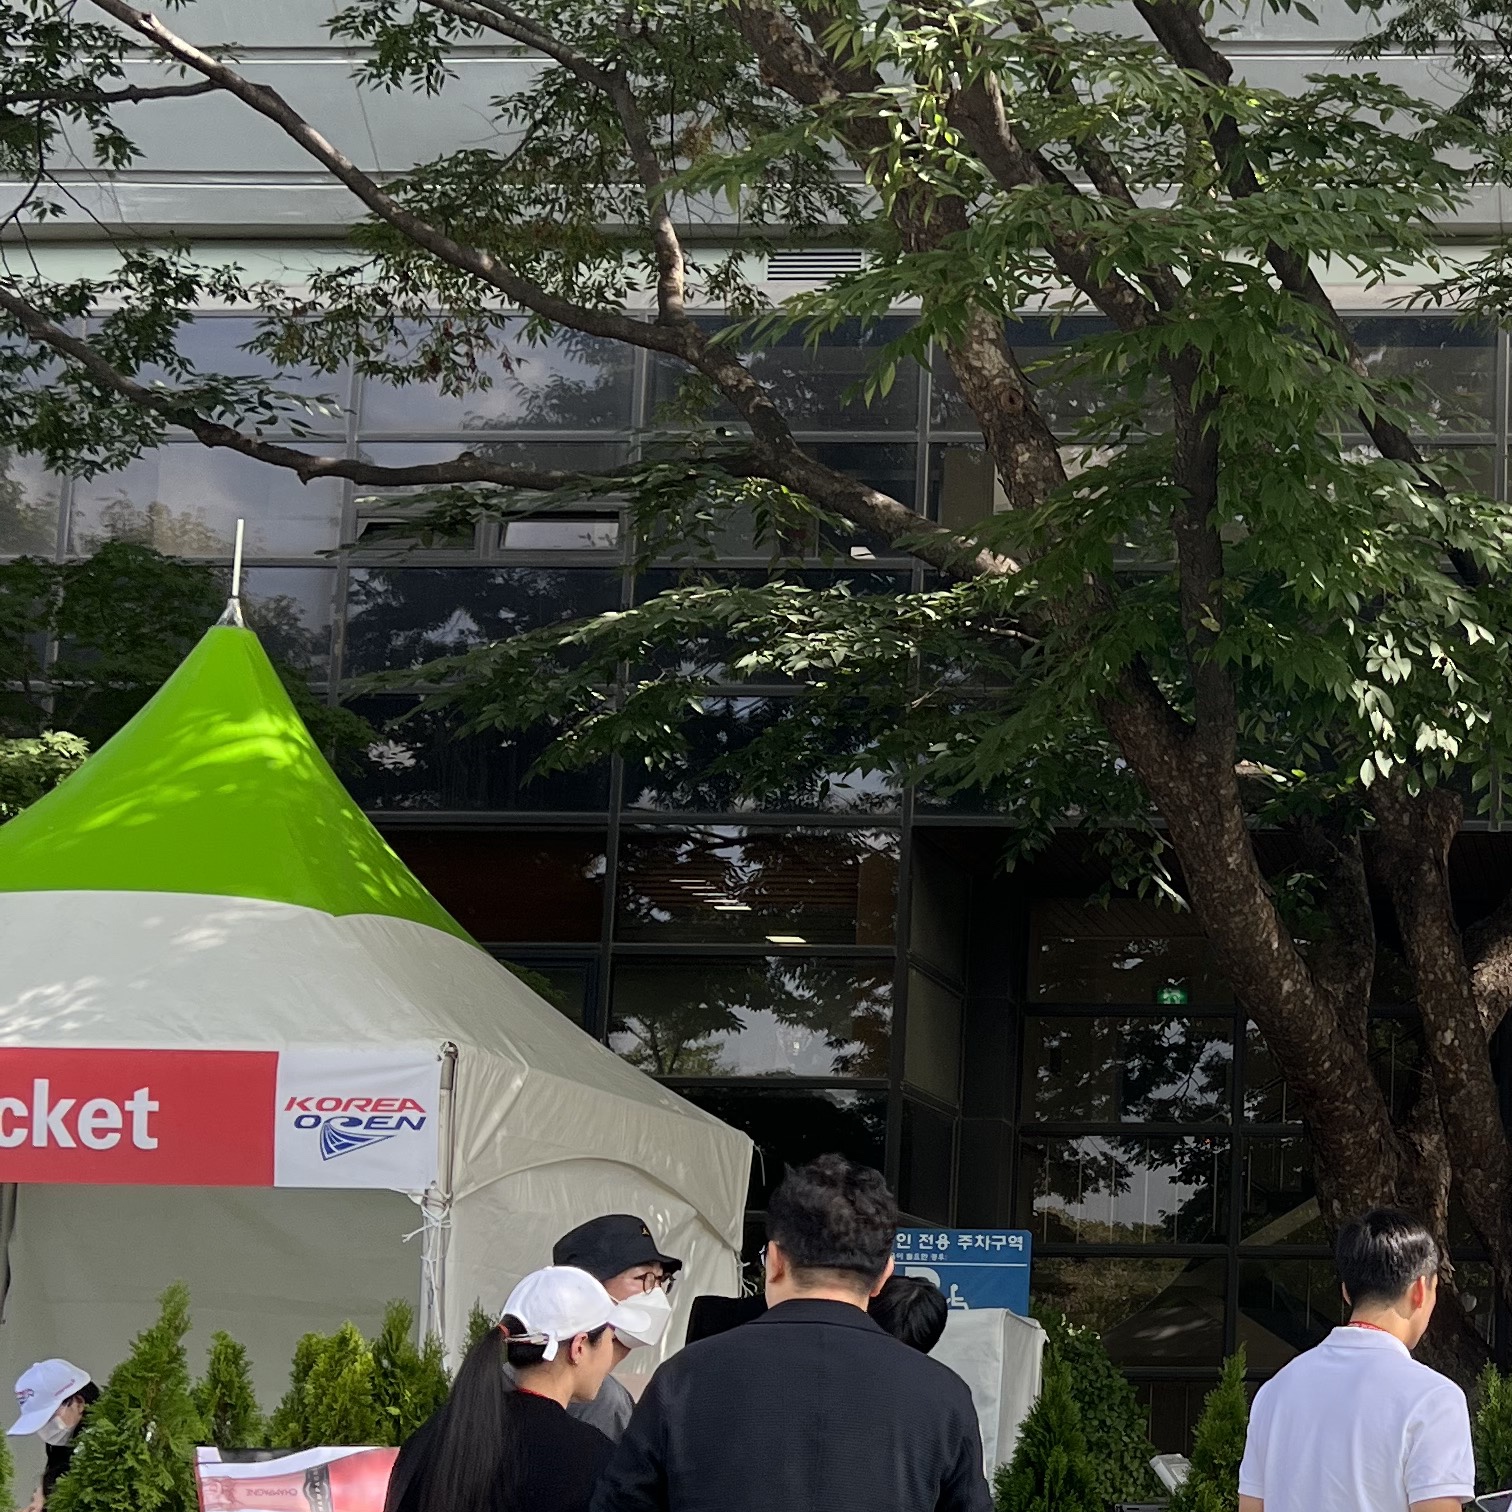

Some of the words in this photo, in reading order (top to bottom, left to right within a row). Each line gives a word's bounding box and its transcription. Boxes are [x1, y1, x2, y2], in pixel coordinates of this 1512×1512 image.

[0, 1078, 160, 1150] cket
[284, 1096, 427, 1114] KOREA
[294, 1114, 427, 1131] OPEN
[919, 1233, 951, 1251] 전용
[957, 1234, 1024, 1252] 주차구역
